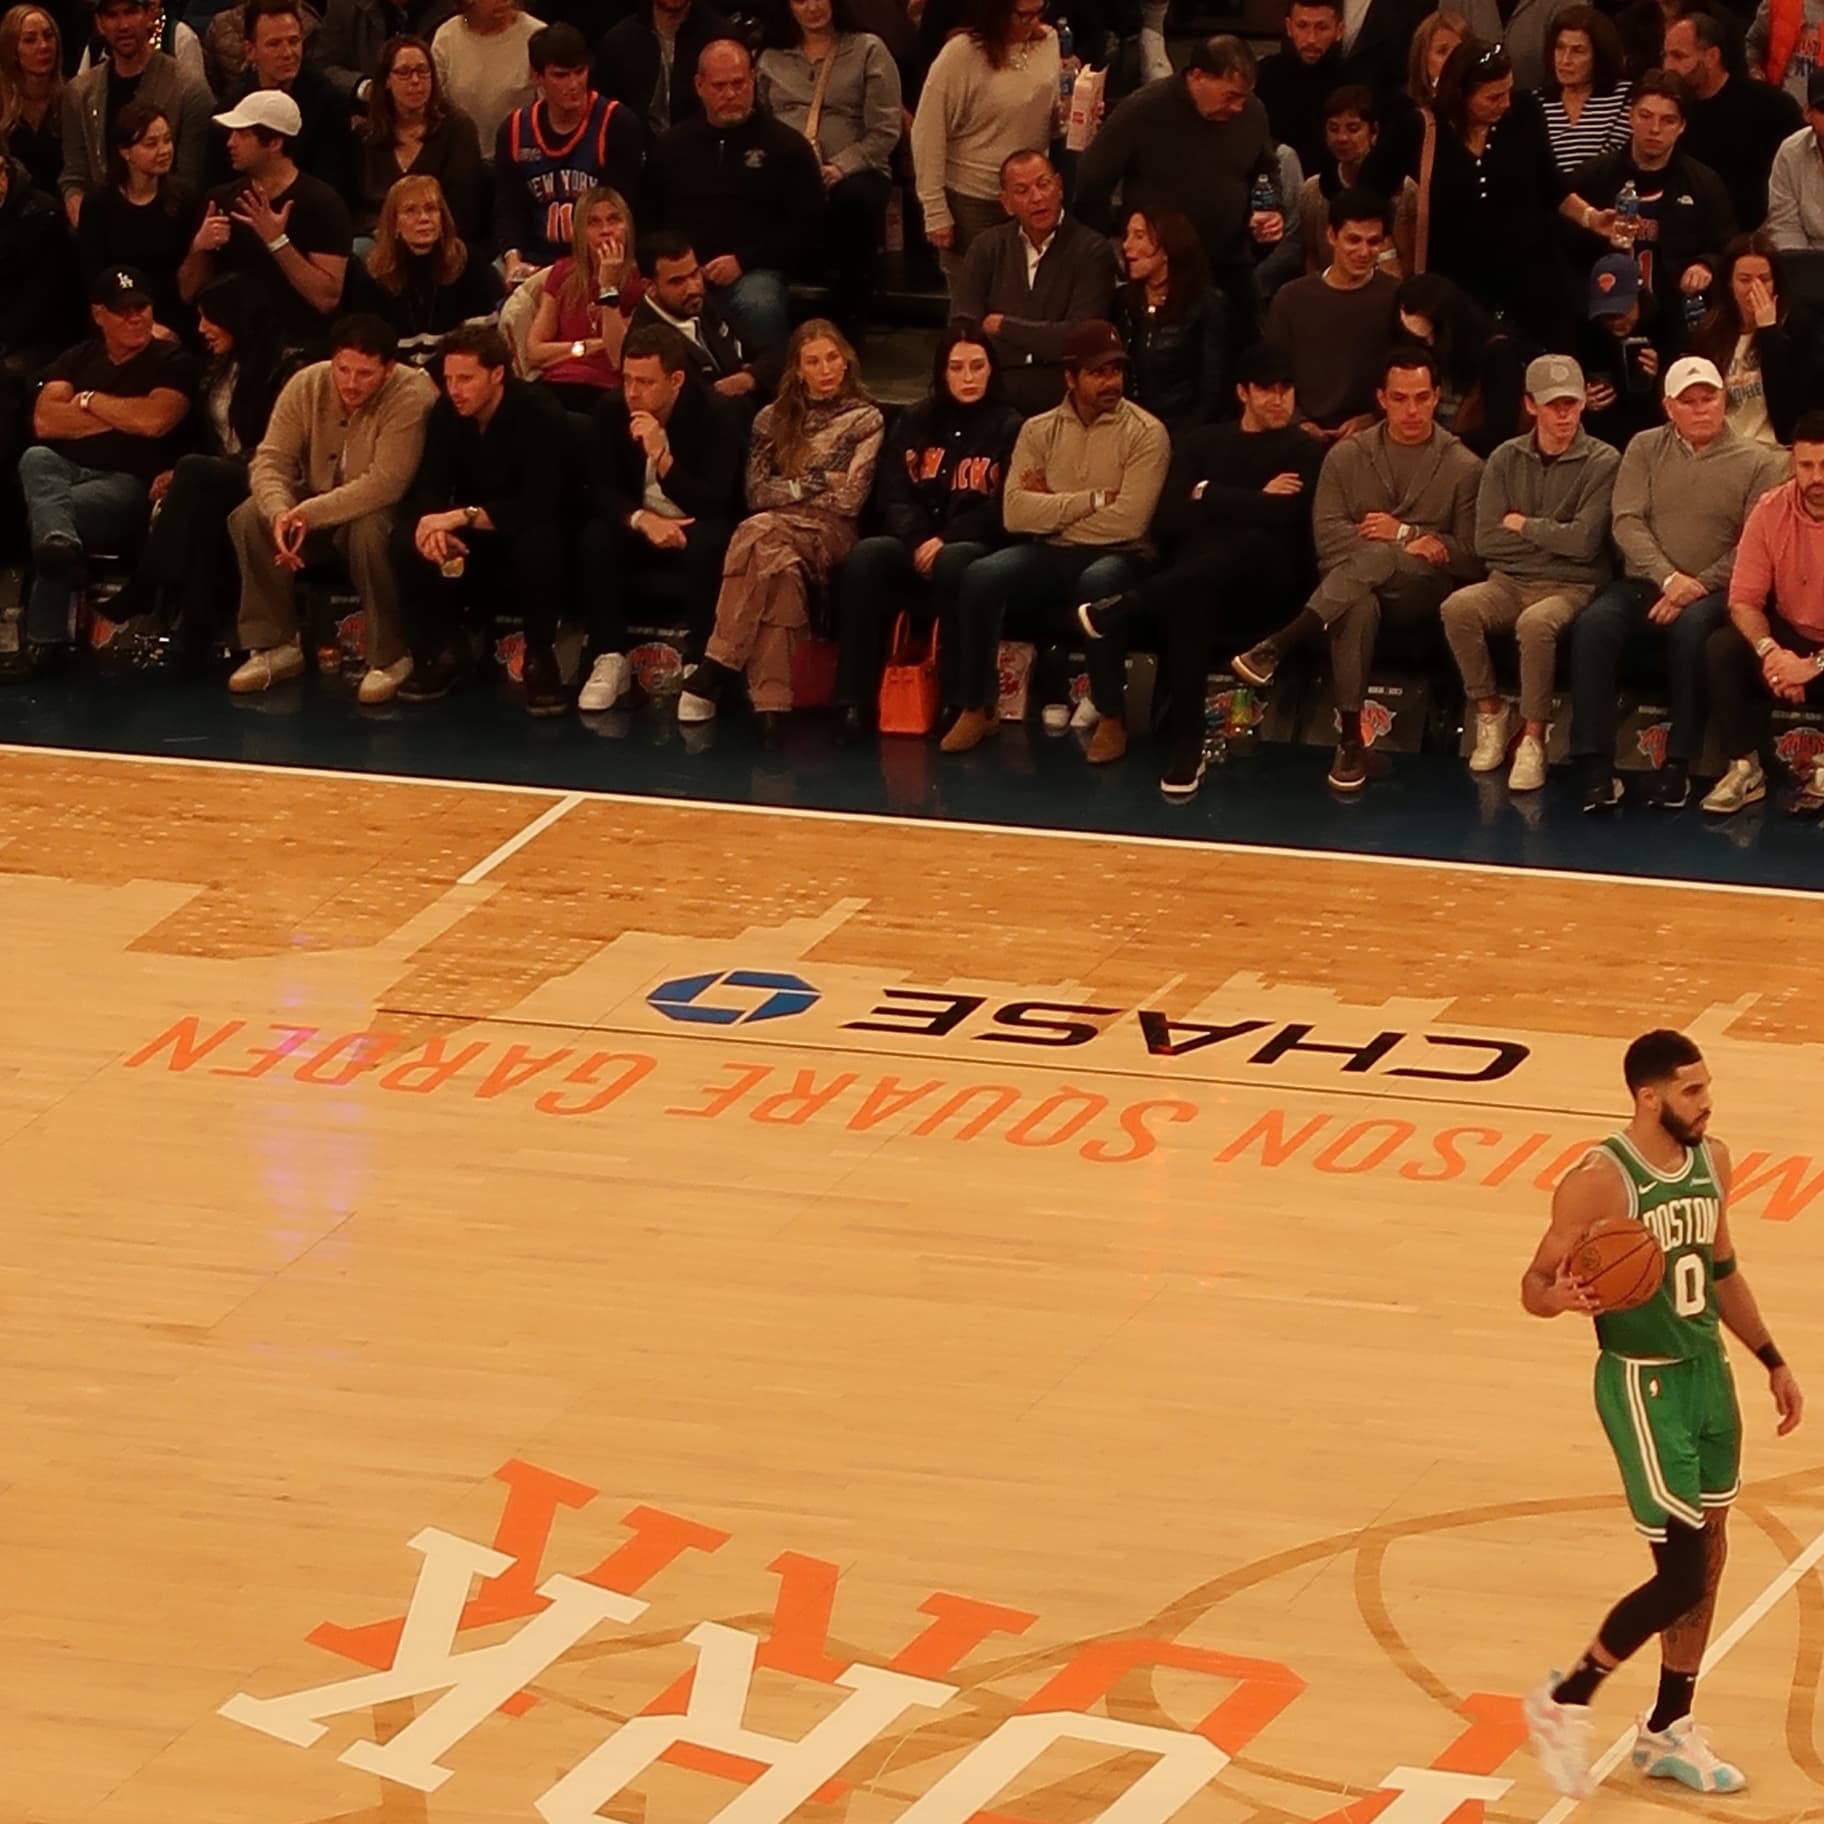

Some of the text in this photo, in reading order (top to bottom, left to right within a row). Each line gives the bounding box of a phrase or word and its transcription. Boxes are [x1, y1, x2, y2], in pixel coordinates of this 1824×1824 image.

[124, 1014, 662, 1118] GARDEN
[845, 988, 1530, 1082] CHASE
[663, 1060, 1203, 1164] SQUARE
[1673, 1252, 1707, 1320] 0
